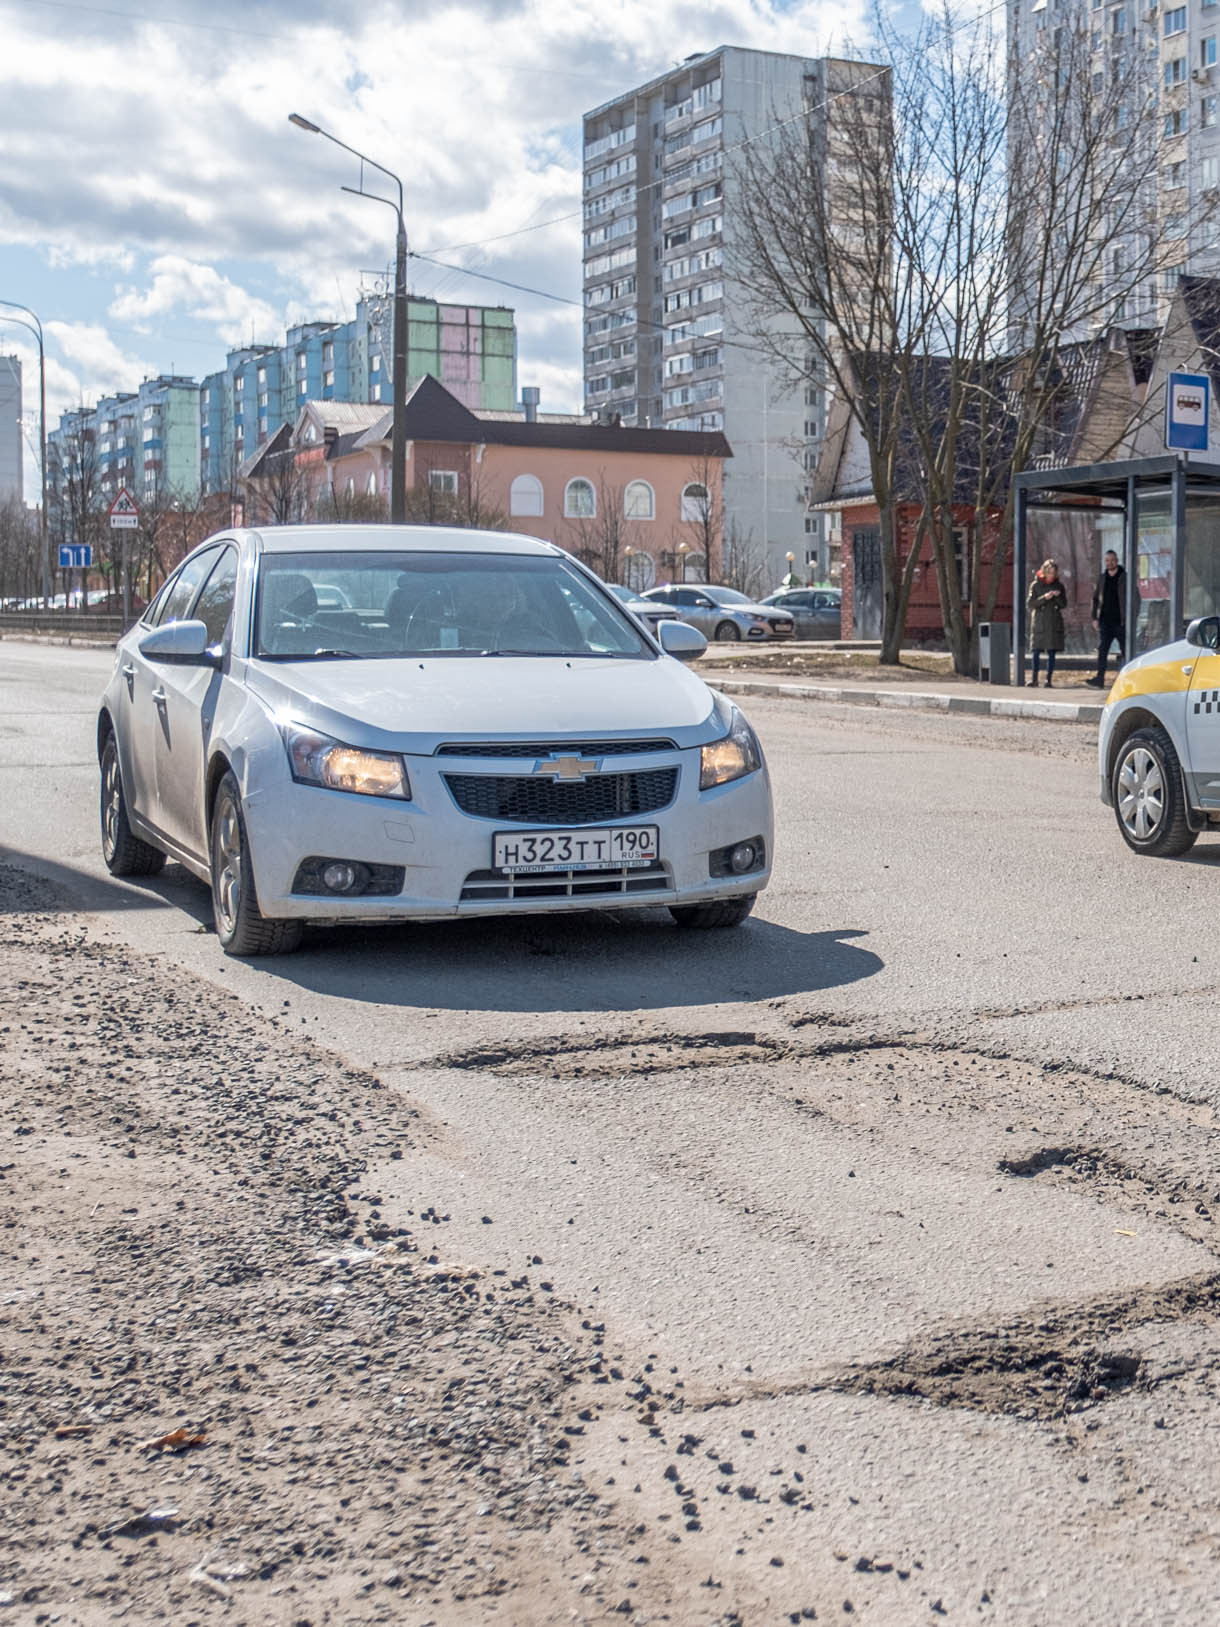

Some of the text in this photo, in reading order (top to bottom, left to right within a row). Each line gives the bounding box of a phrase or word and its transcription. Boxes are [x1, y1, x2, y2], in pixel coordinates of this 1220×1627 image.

[504, 831, 650, 865] Н323ТТ 190
[621, 850, 642, 859] RUS
